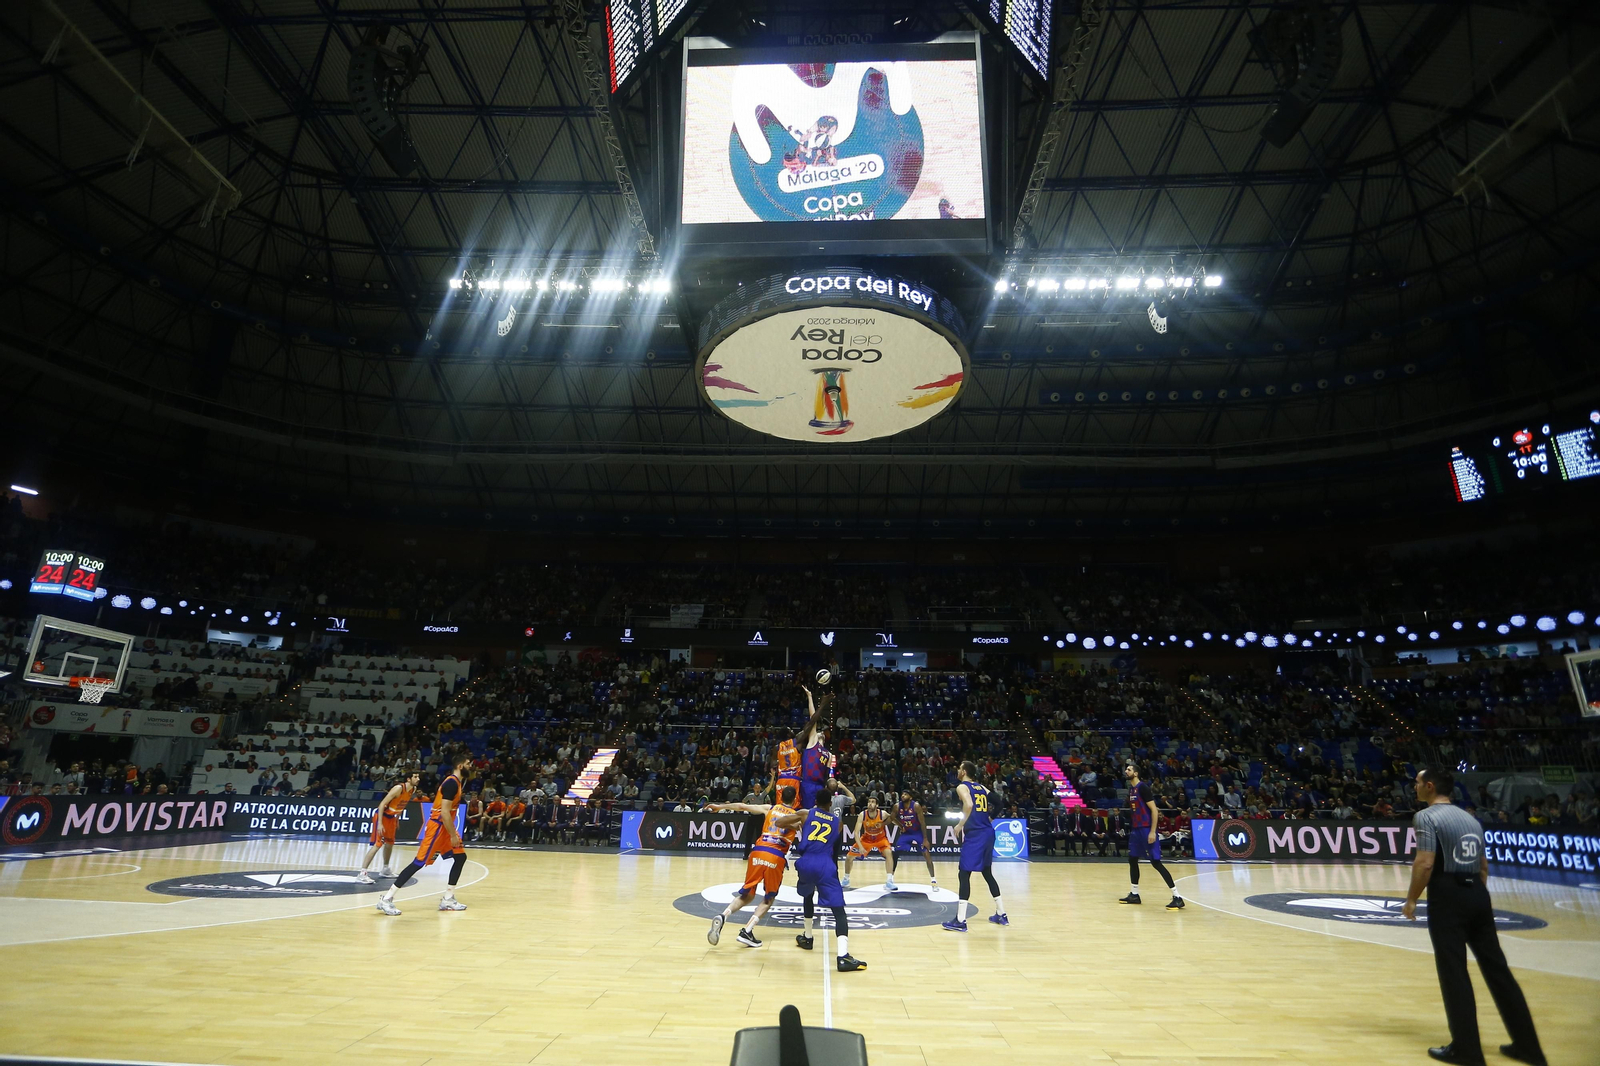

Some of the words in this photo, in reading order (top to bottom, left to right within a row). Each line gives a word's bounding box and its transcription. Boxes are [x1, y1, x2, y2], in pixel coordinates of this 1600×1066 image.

[787, 166, 851, 187] Málaga
[803, 192, 863, 213] Copa
[785, 276, 850, 294] Copa
[856, 275, 893, 296] del
[898, 282, 933, 311] Rey
[807, 317, 831, 325] 2020
[832, 318, 876, 327] Málaga
[790, 325, 845, 344] Rey
[850, 335, 883, 346] del
[802, 346, 882, 363] Copa
[1542, 425, 1550, 435] 0
[1493, 437, 1501, 447] 0
[1513, 453, 1547, 468] 10:00
[1540, 464, 1548, 473] 0
[1517, 469, 1525, 479] 0
[45, 552, 74, 563] 10:00
[77, 555, 104, 571] 10:00
[36, 565, 65, 583] 24
[69, 569, 97, 590] 24
[423, 625, 459, 633] #CopaACB
[233, 802, 336, 817] PATROCINADOR
[974, 794, 988, 812] 30
[61, 801, 227, 836] MOVISTAR
[814, 811, 834, 821] HIGGINS
[250, 817, 267, 829] DE
[272, 818, 288, 830] LA
[292, 819, 327, 831] COPA
[337, 821, 356, 833] DEL
[807, 820, 832, 843] 22
[687, 841, 734, 849] PATROCINADOR
[1005, 841, 1017, 849] Rey
[1266, 826, 1417, 854] MOVISTA
[1484, 830, 1559, 849] OCINADOR
[1461, 841, 1477, 857] 50
[1496, 848, 1514, 862] LA
[1517, 850, 1558, 868] COPA
[1561, 853, 1595, 871] DEL
